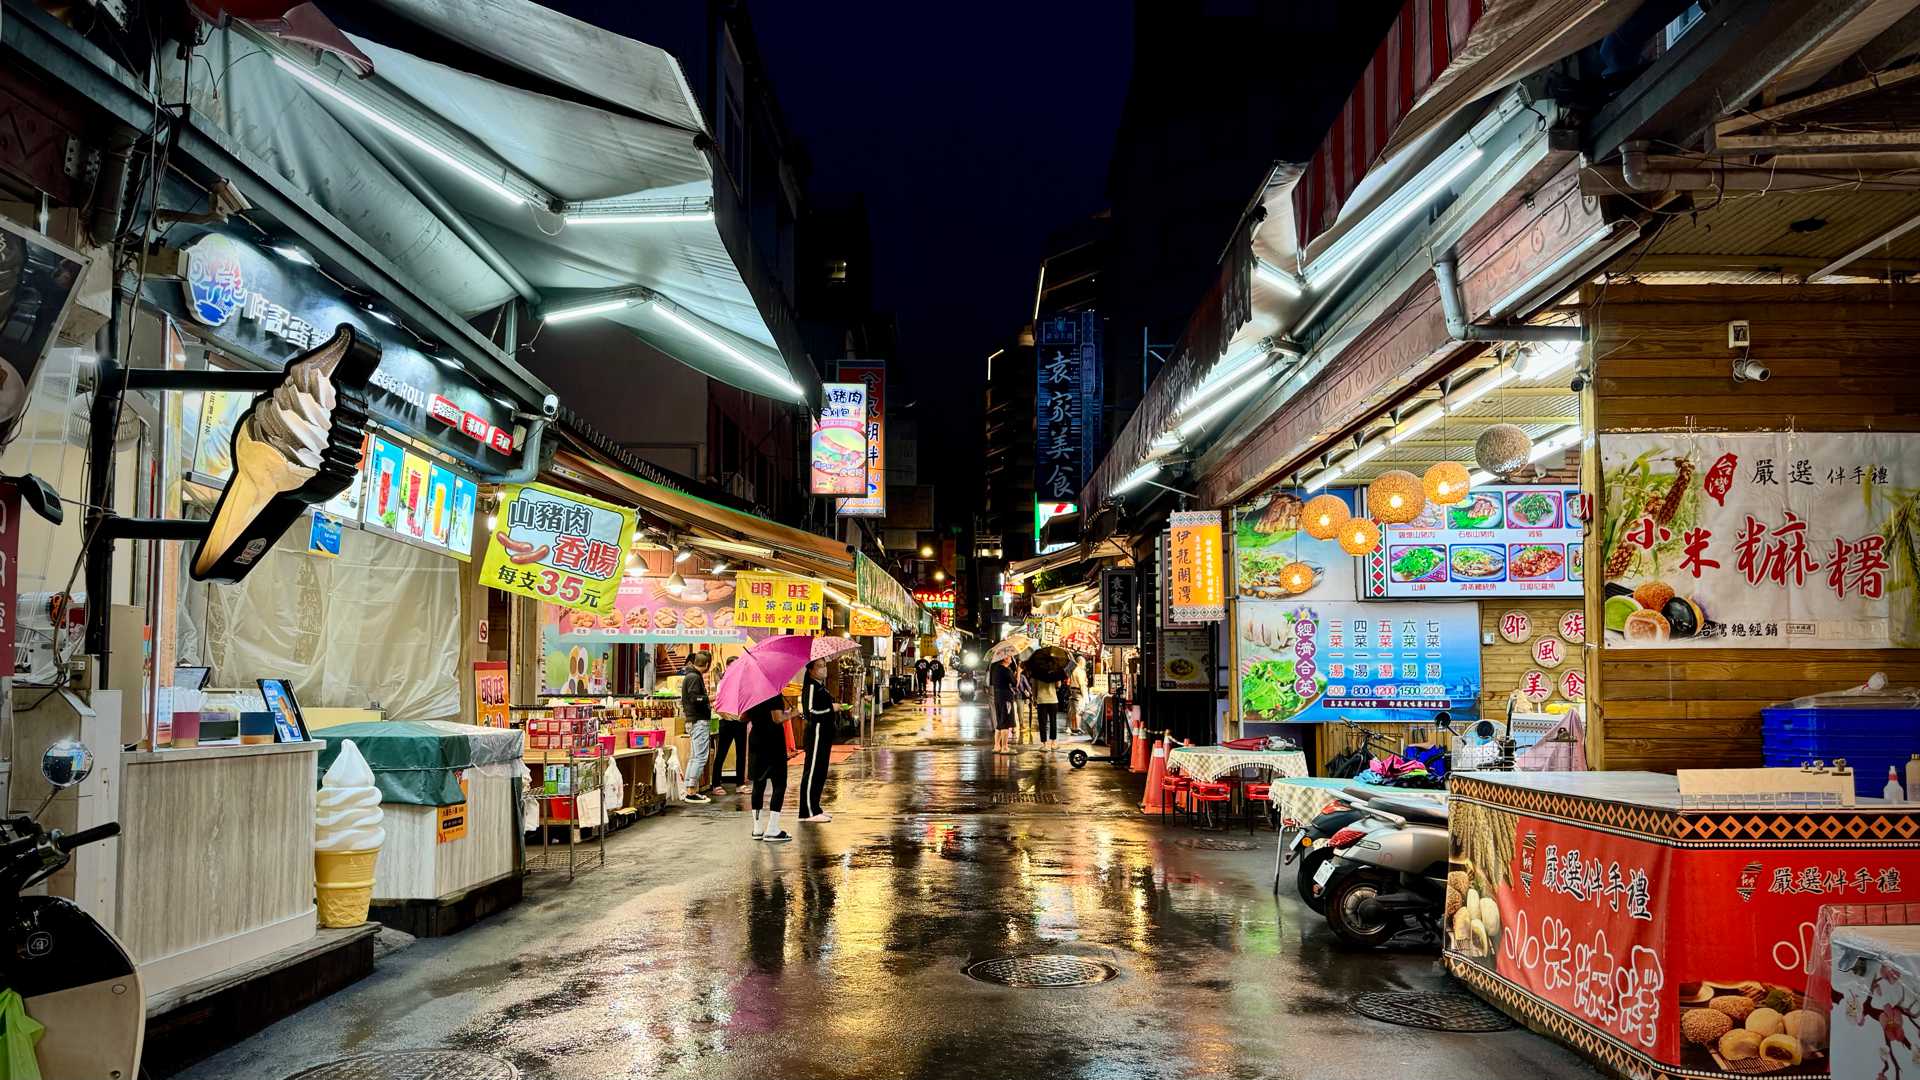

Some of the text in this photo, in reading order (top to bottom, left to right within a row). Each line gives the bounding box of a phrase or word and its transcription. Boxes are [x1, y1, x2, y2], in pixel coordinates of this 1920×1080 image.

[399, 381, 426, 408] ROLL
[1045, 350, 1075, 498] 袁家美食
[1708, 458, 1733, 494] 台灣
[1751, 459, 1890, 486] 嚴選伴手禮
[509, 499, 592, 535] 山豬肉
[553, 534, 620, 578] 香腸
[498, 565, 601, 608] 每支35元
[751, 582, 810, 600] 明旺
[1702, 623, 1779, 638] 台灣總經銷
[1297, 622, 1314, 694] 經濟合菜
[1353, 686, 1370, 696] 800
[1375, 686, 1396, 696] 1200
[1399, 686, 1421, 696] 1500
[1542, 845, 1653, 922] 嚴選伴手禮
[1768, 866, 1903, 895] 嚴選伴手禮
